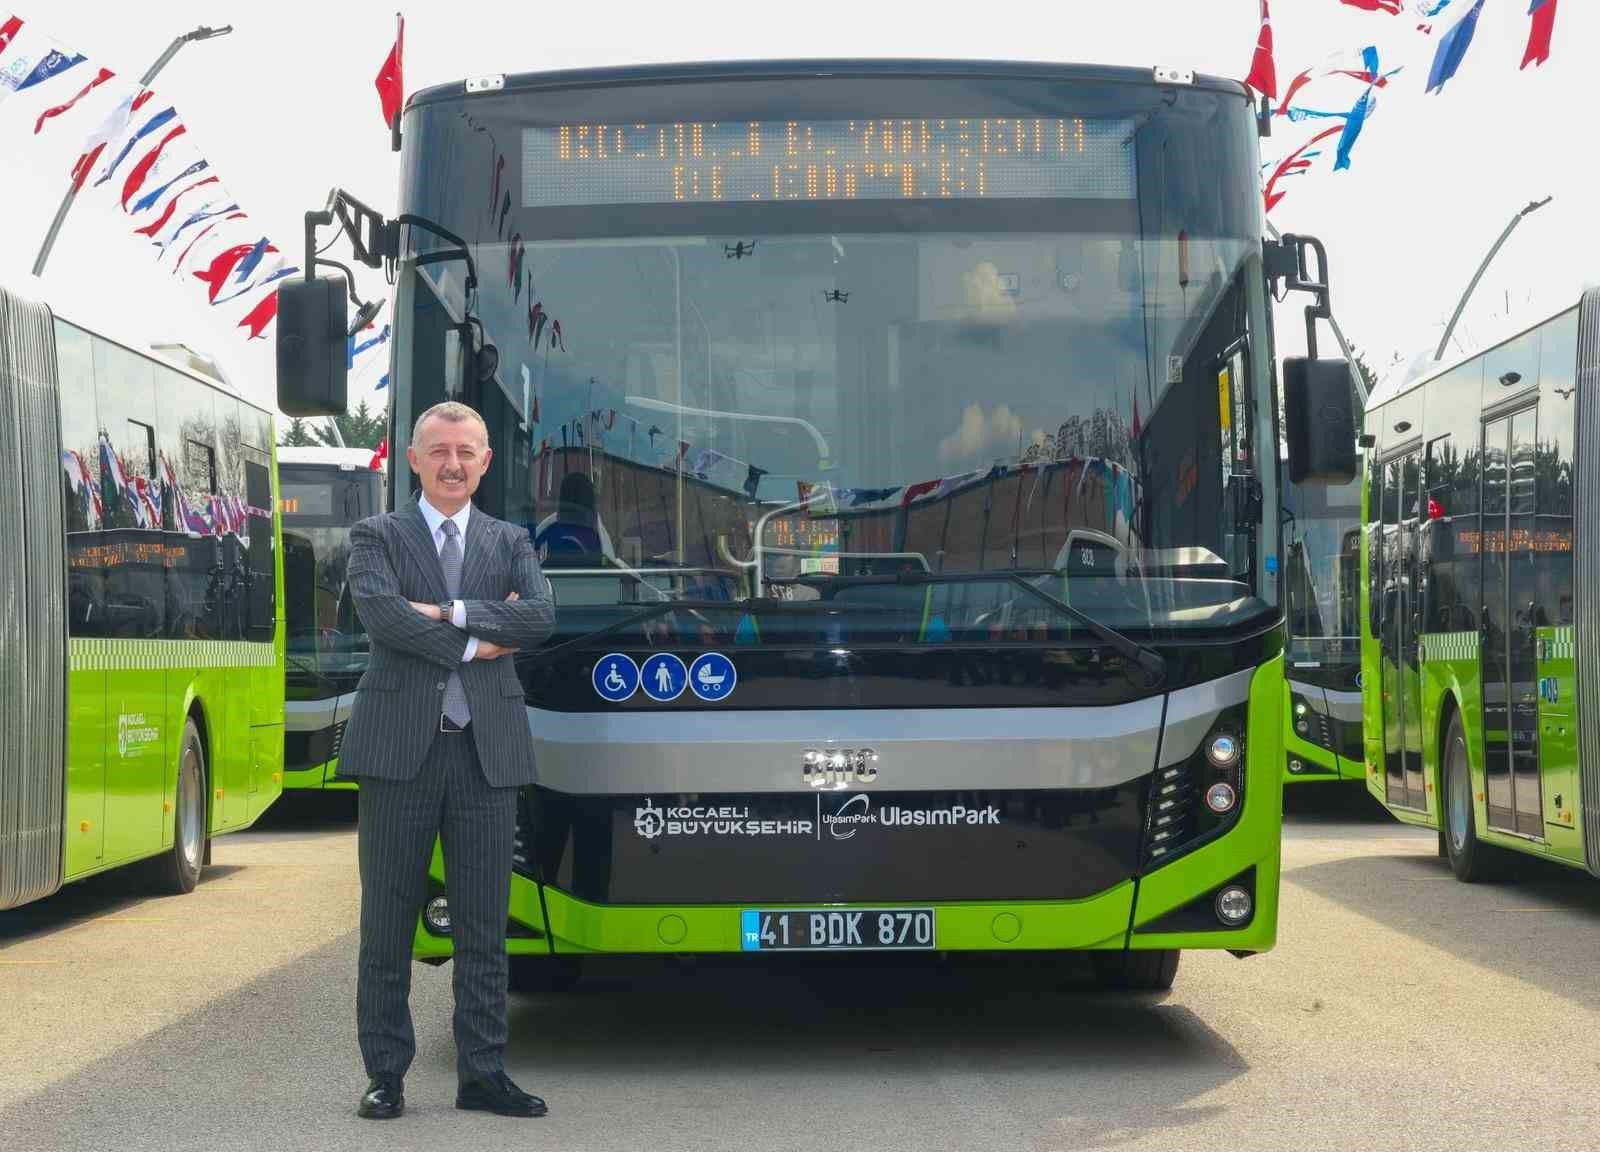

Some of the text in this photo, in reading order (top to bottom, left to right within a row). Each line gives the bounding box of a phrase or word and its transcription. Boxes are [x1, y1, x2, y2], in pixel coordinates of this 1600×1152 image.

[745, 932, 759, 942] TR
[760, 912, 930, 945] 41 BDK 870
